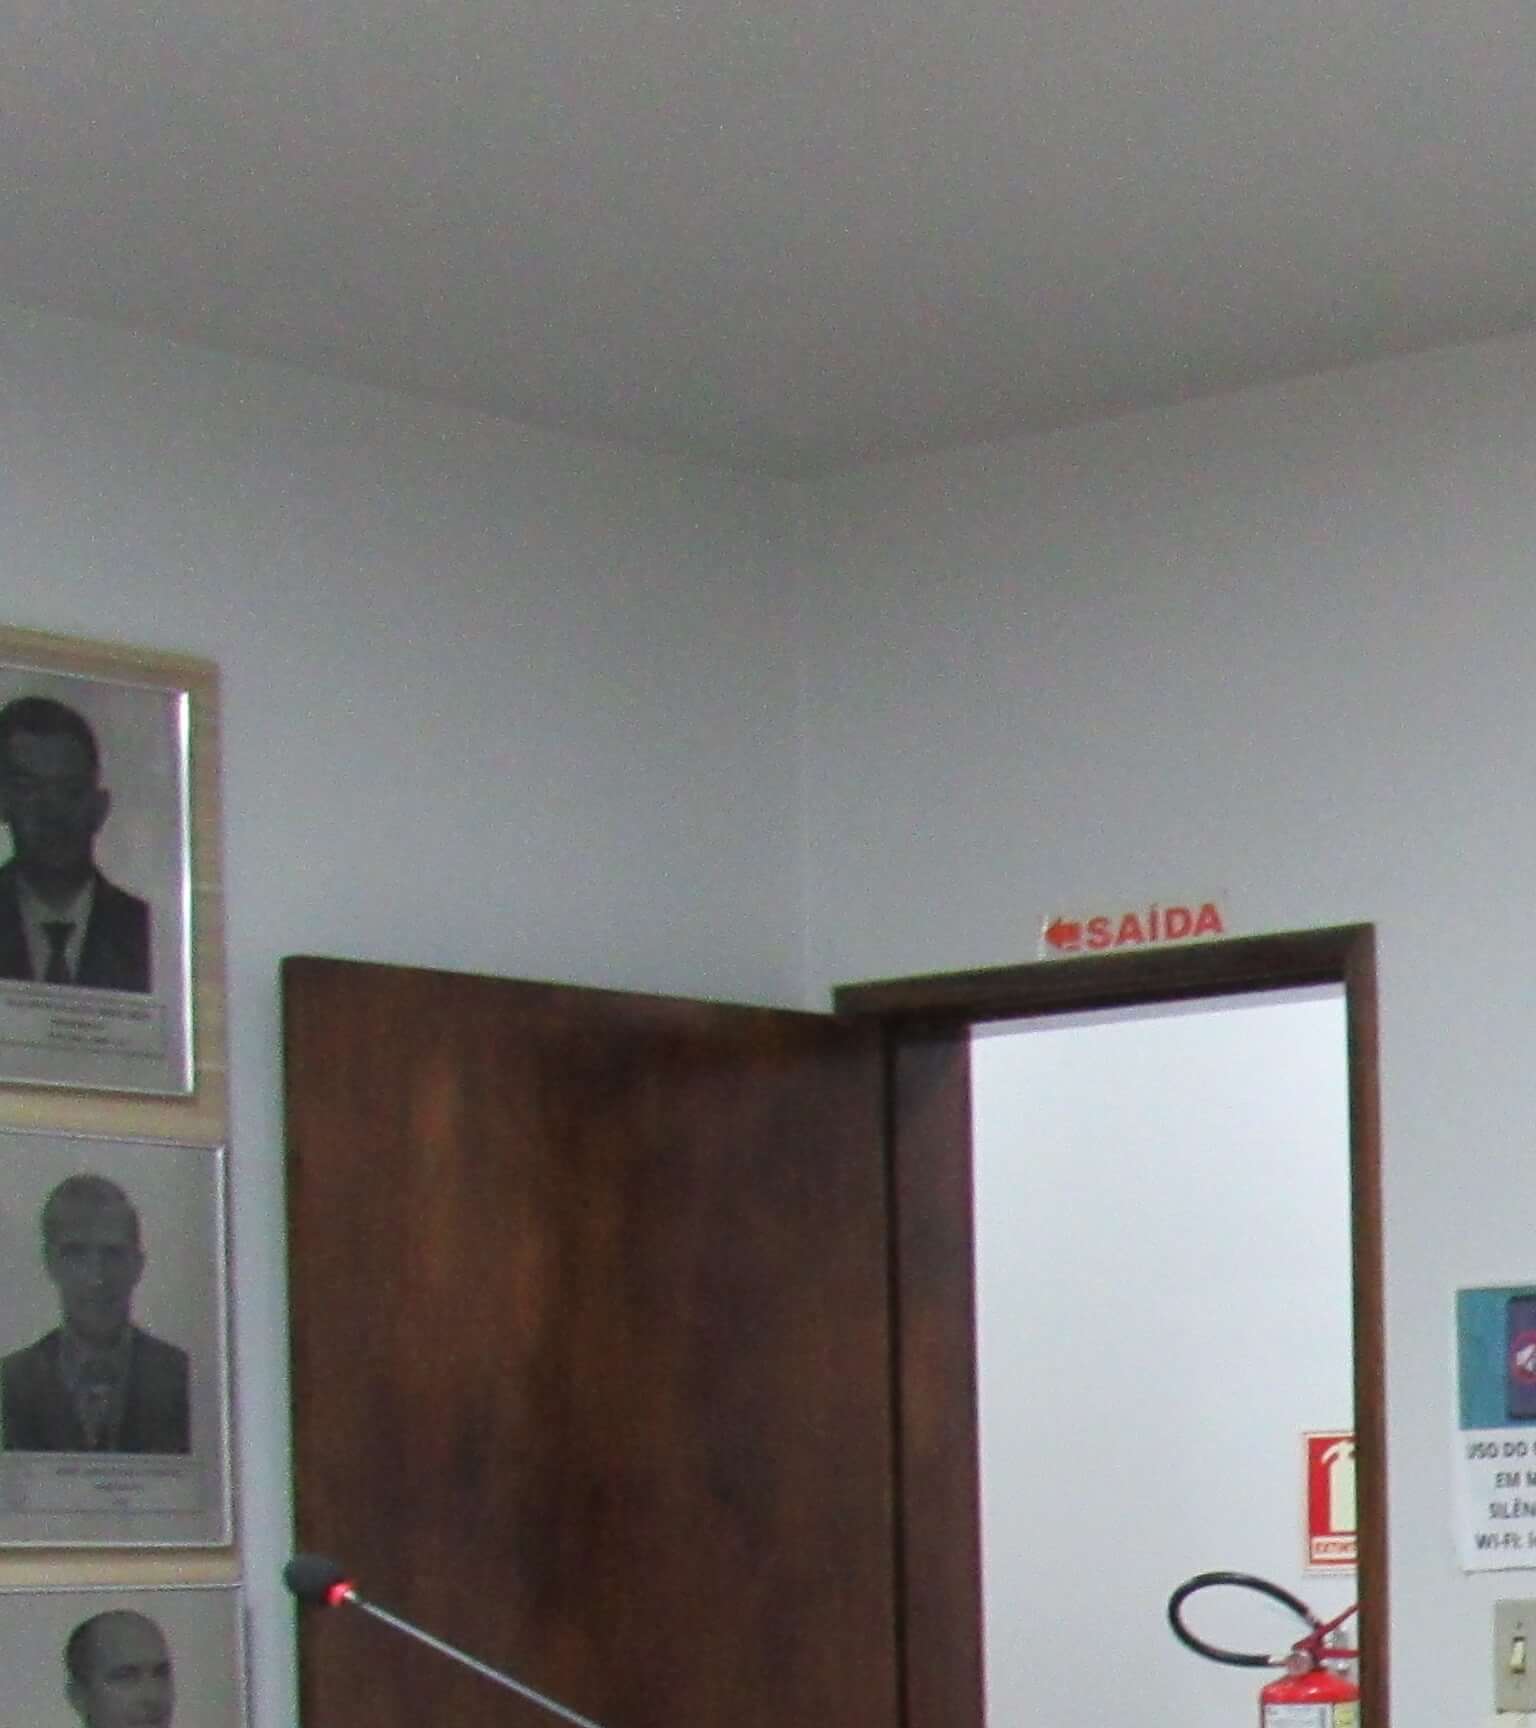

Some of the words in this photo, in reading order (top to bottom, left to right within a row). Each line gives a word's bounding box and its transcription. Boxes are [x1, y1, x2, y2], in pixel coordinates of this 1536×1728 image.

[1086, 903, 1224, 949] SAÍDA
[1503, 1441, 1528, 1457] DO
[1495, 1471, 1520, 1488] EM
